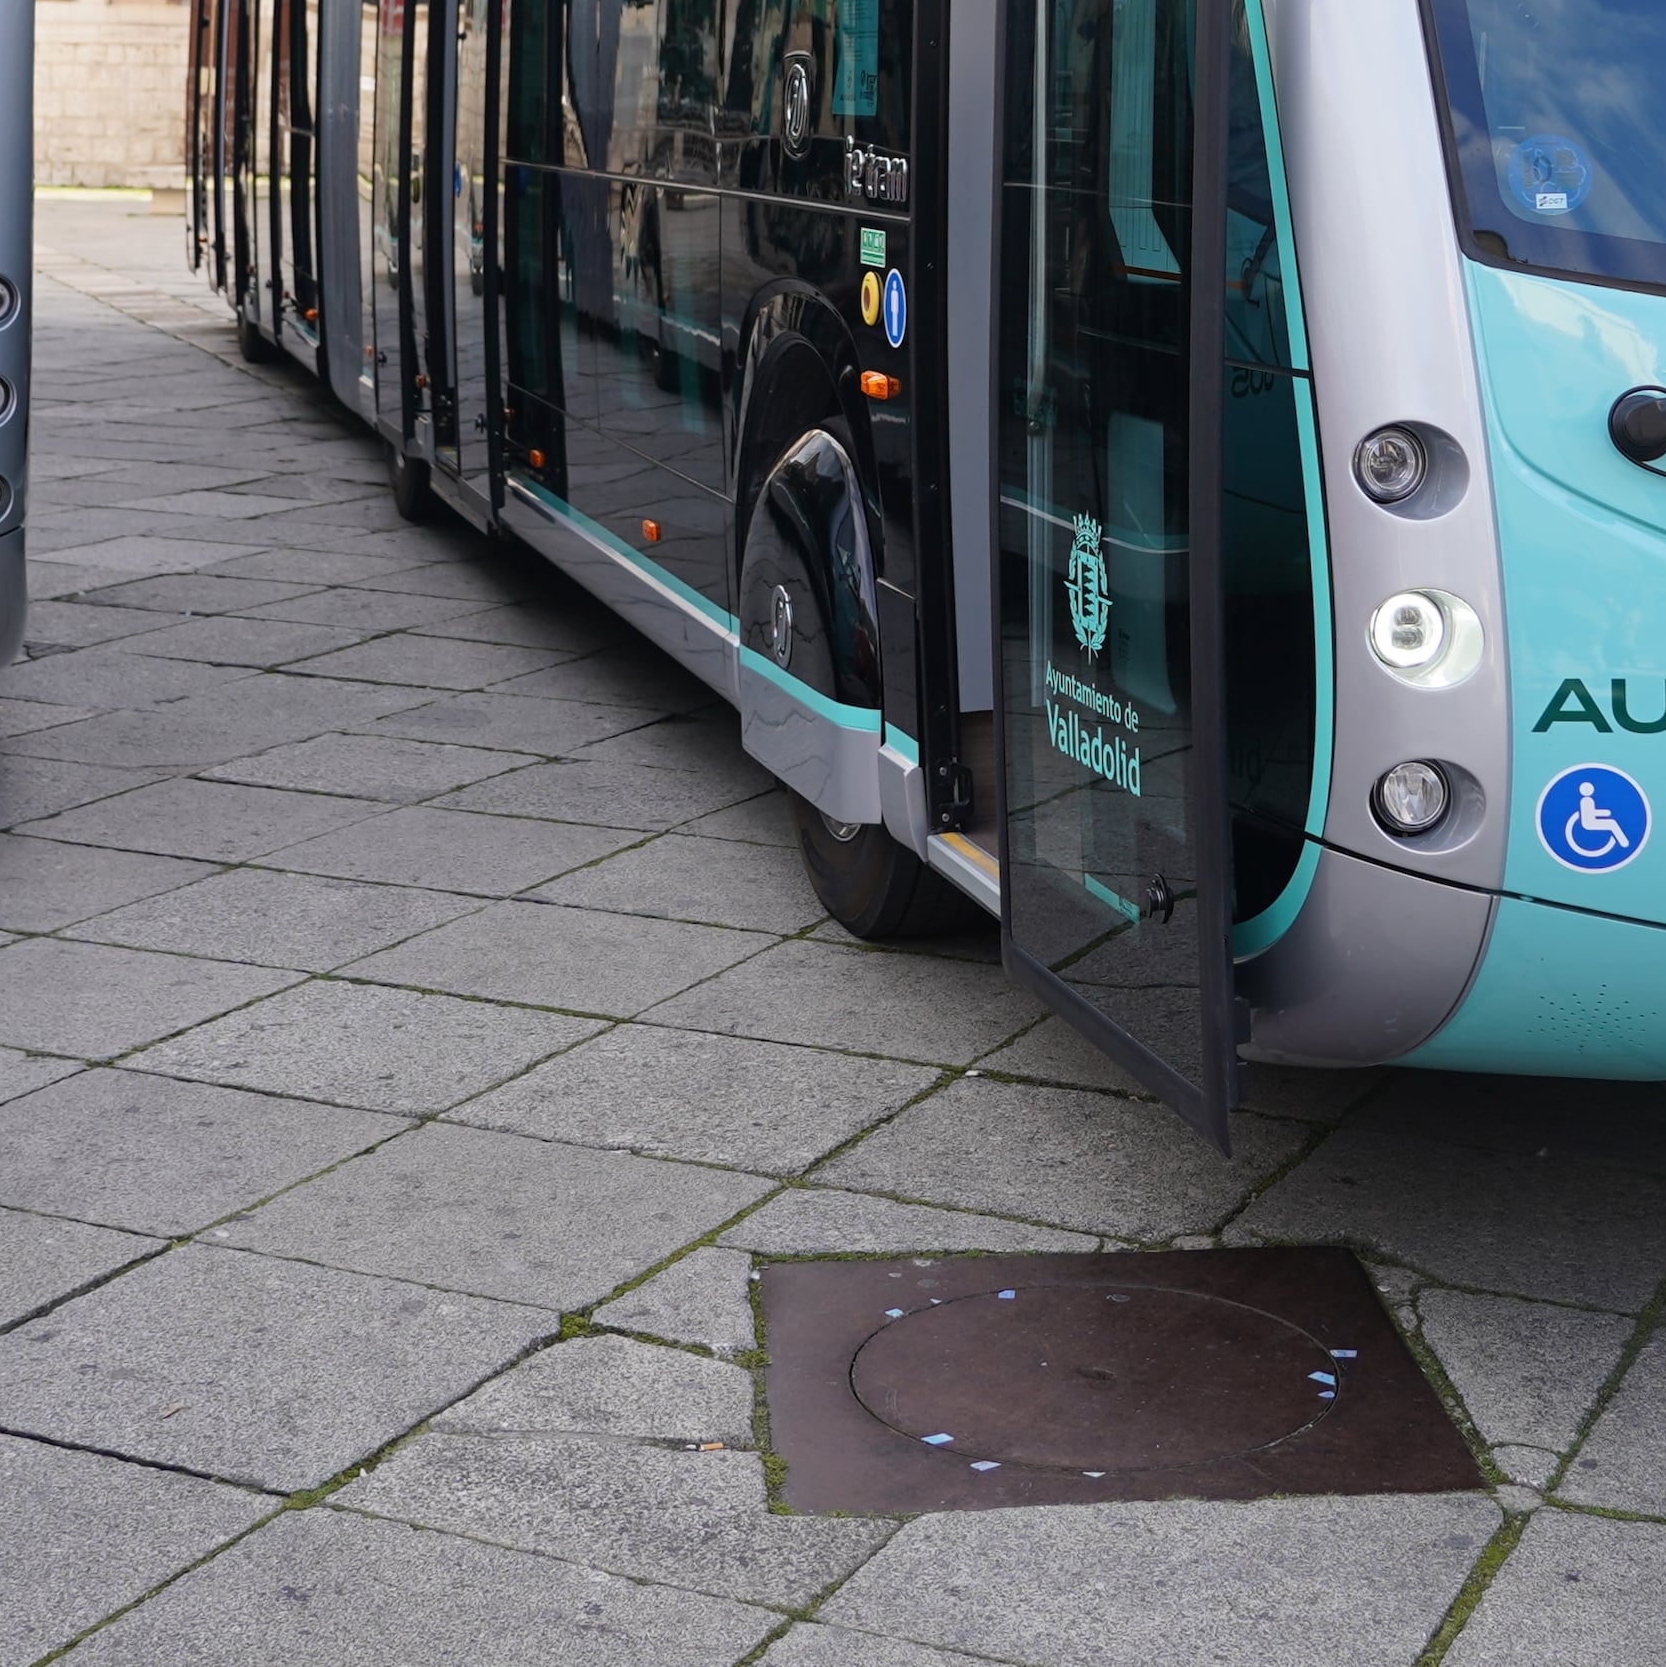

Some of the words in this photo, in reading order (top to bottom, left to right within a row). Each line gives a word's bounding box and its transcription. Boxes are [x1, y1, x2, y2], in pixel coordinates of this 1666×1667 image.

[1045, 659, 1122, 722] Ayuntamiento
[1124, 701, 1139, 734] de
[1045, 699, 1142, 798] Valladolid
